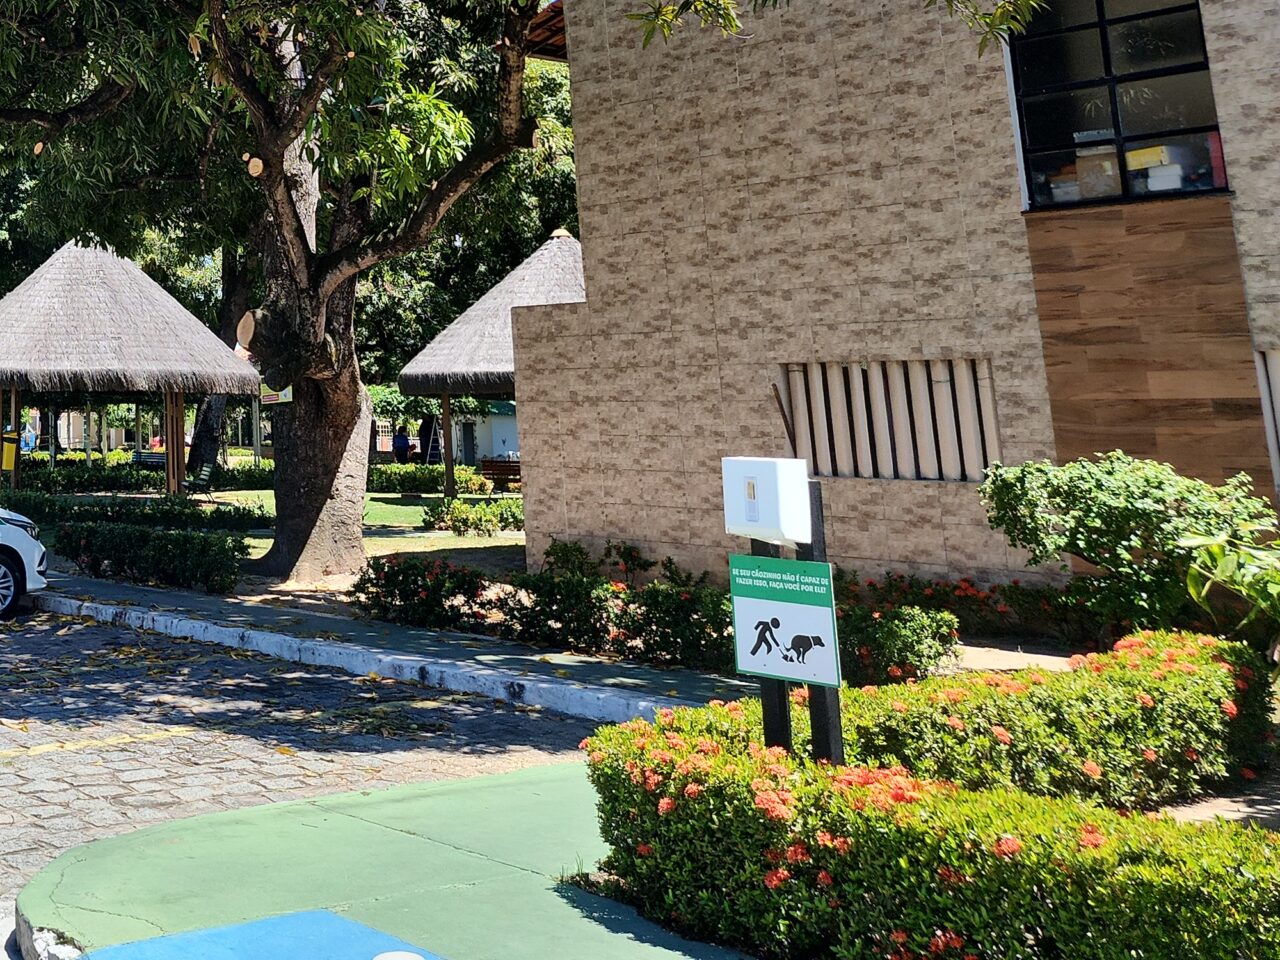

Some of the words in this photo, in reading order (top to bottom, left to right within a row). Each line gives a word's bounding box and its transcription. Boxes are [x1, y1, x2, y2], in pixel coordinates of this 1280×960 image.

[732, 568, 739, 576] SE
[740, 569, 750, 577] SEU
[751, 570, 781, 580] CÃOZINHO
[782, 572, 795, 581] NÃO
[800, 575, 820, 584] CAPAZ
[736, 577, 753, 585] FAZER
[753, 580, 769, 588] ISSO,
[769, 581, 784, 589] FAÇA
[784, 583, 800, 591] VOCÊ
